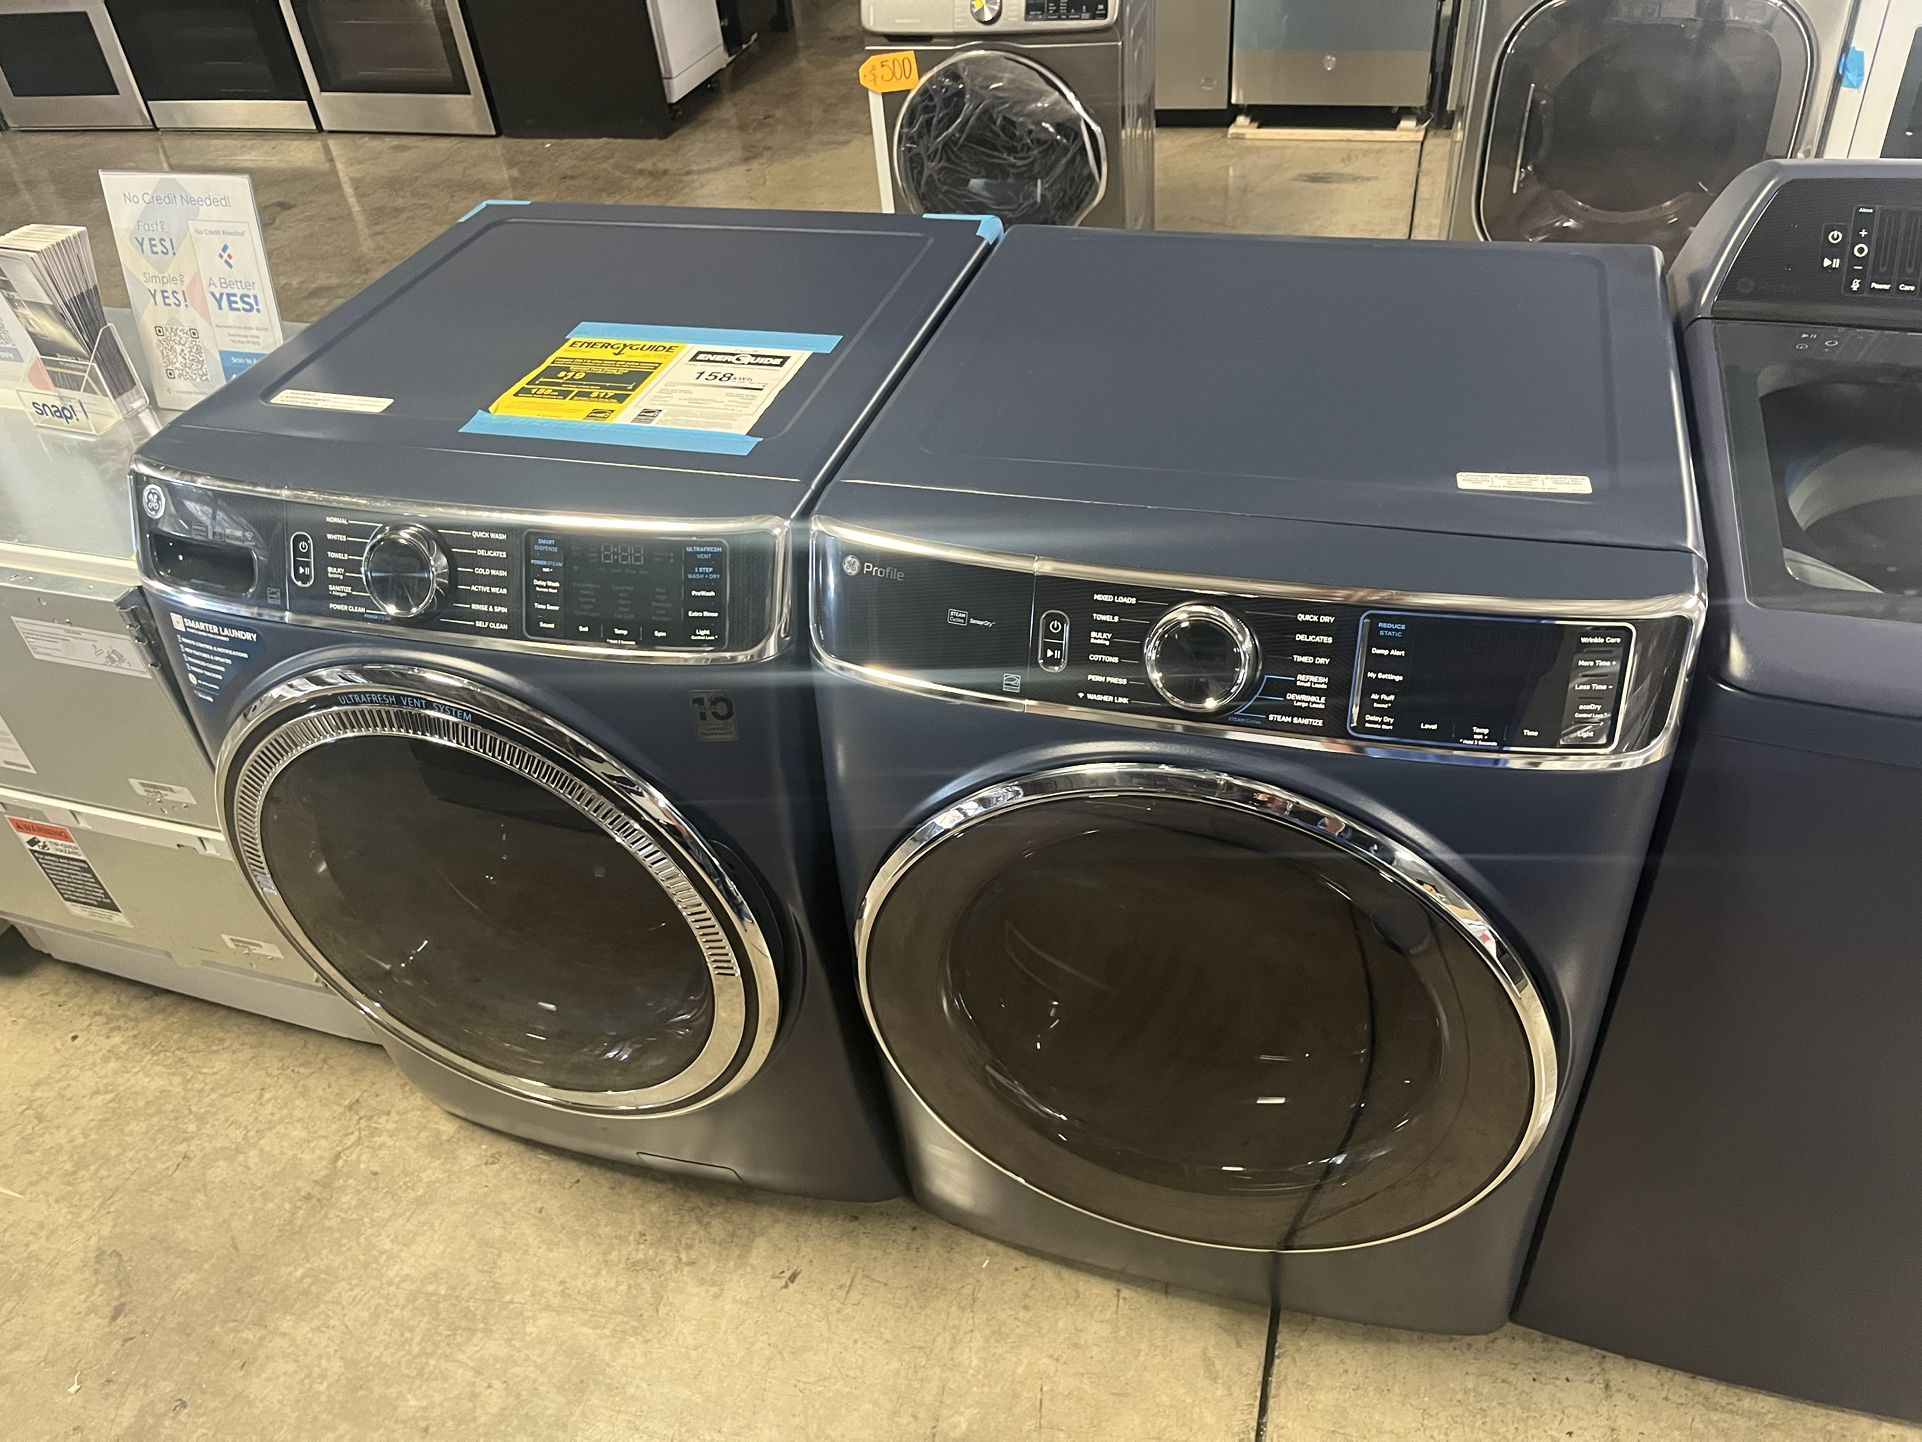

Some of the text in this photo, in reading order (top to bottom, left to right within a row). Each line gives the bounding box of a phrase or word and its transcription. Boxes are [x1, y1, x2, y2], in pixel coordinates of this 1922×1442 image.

[870, 57, 912, 87] $500
[123, 192, 232, 208] No Credit Needed!
[136, 221, 166, 233] Fast?
[134, 236, 177, 256] YES!
[142, 272, 185, 287] Simple?
[208, 277, 257, 291] A Better
[1870, 282, 1892, 290] Power
[1898, 283, 1916, 291] Care
[149, 289, 189, 308] YES!
[208, 291, 262, 314] YES!
[568, 340, 679, 355] ENERGYGUIDE
[694, 370, 735, 382] 158
[31, 400, 80, 425] snap!
[326, 516, 348, 524] NORMAL
[326, 533, 347, 542] WHITES
[472, 530, 507, 540] QUICK WASH
[534, 544, 558, 552] DISPENSE
[327, 551, 348, 560] TOWELS
[477, 549, 507, 558] DELICATES
[327, 566, 345, 574] BULKY
[474, 567, 508, 577] COLD WASH
[863, 562, 905, 581] Profile
[533, 578, 547, 587] Delay
[328, 584, 352, 592] SANITIZE
[470, 584, 508, 595] ACTIVE WEAR
[1093, 593, 1137, 604] MIXED LOADS
[329, 603, 366, 613] POWER CLEAN
[471, 603, 489, 612] RINSE
[494, 605, 508, 614] SPIN
[534, 602, 546, 610] Time
[950, 610, 966, 618] STEAM
[1092, 613, 1119, 623] TOWELS
[1296, 613, 1336, 624] QUICK DRY
[183, 617, 219, 634] SMARTER
[219, 626, 257, 642] LAUNDRY
[475, 620, 509, 630] SELF CLEAN
[539, 621, 555, 629] Sound
[1378, 622, 1406, 630] REDUCE
[613, 628, 629, 636] Temp
[1090, 631, 1112, 639] BULKY
[1295, 634, 1334, 643] DELICATES
[1371, 647, 1406, 657] Damp Alert
[1088, 654, 1119, 663] COTTONS
[1292, 654, 1331, 665] TIMED DRY
[1087, 674, 1128, 685] PERM PRESS
[1296, 674, 1329, 683] REFRESH
[1367, 671, 1404, 682] My Settings
[1086, 693, 1130, 704] WASHER LINK
[1286, 693, 1326, 703] DEWRINKLE
[1380, 693, 1396, 701] Fluff
[338, 693, 472, 722] ULTRAFRESH VENT SYSTEM
[1293, 700, 1309, 708] Large
[1268, 714, 1324, 726] STEAM SANITIZE
[1365, 714, 1395, 724] Delay Dry
[1420, 722, 1438, 730] Level
[1472, 726, 1490, 735] Temp
[1523, 729, 1539, 737] Time
[1577, 730, 1594, 739] Light
